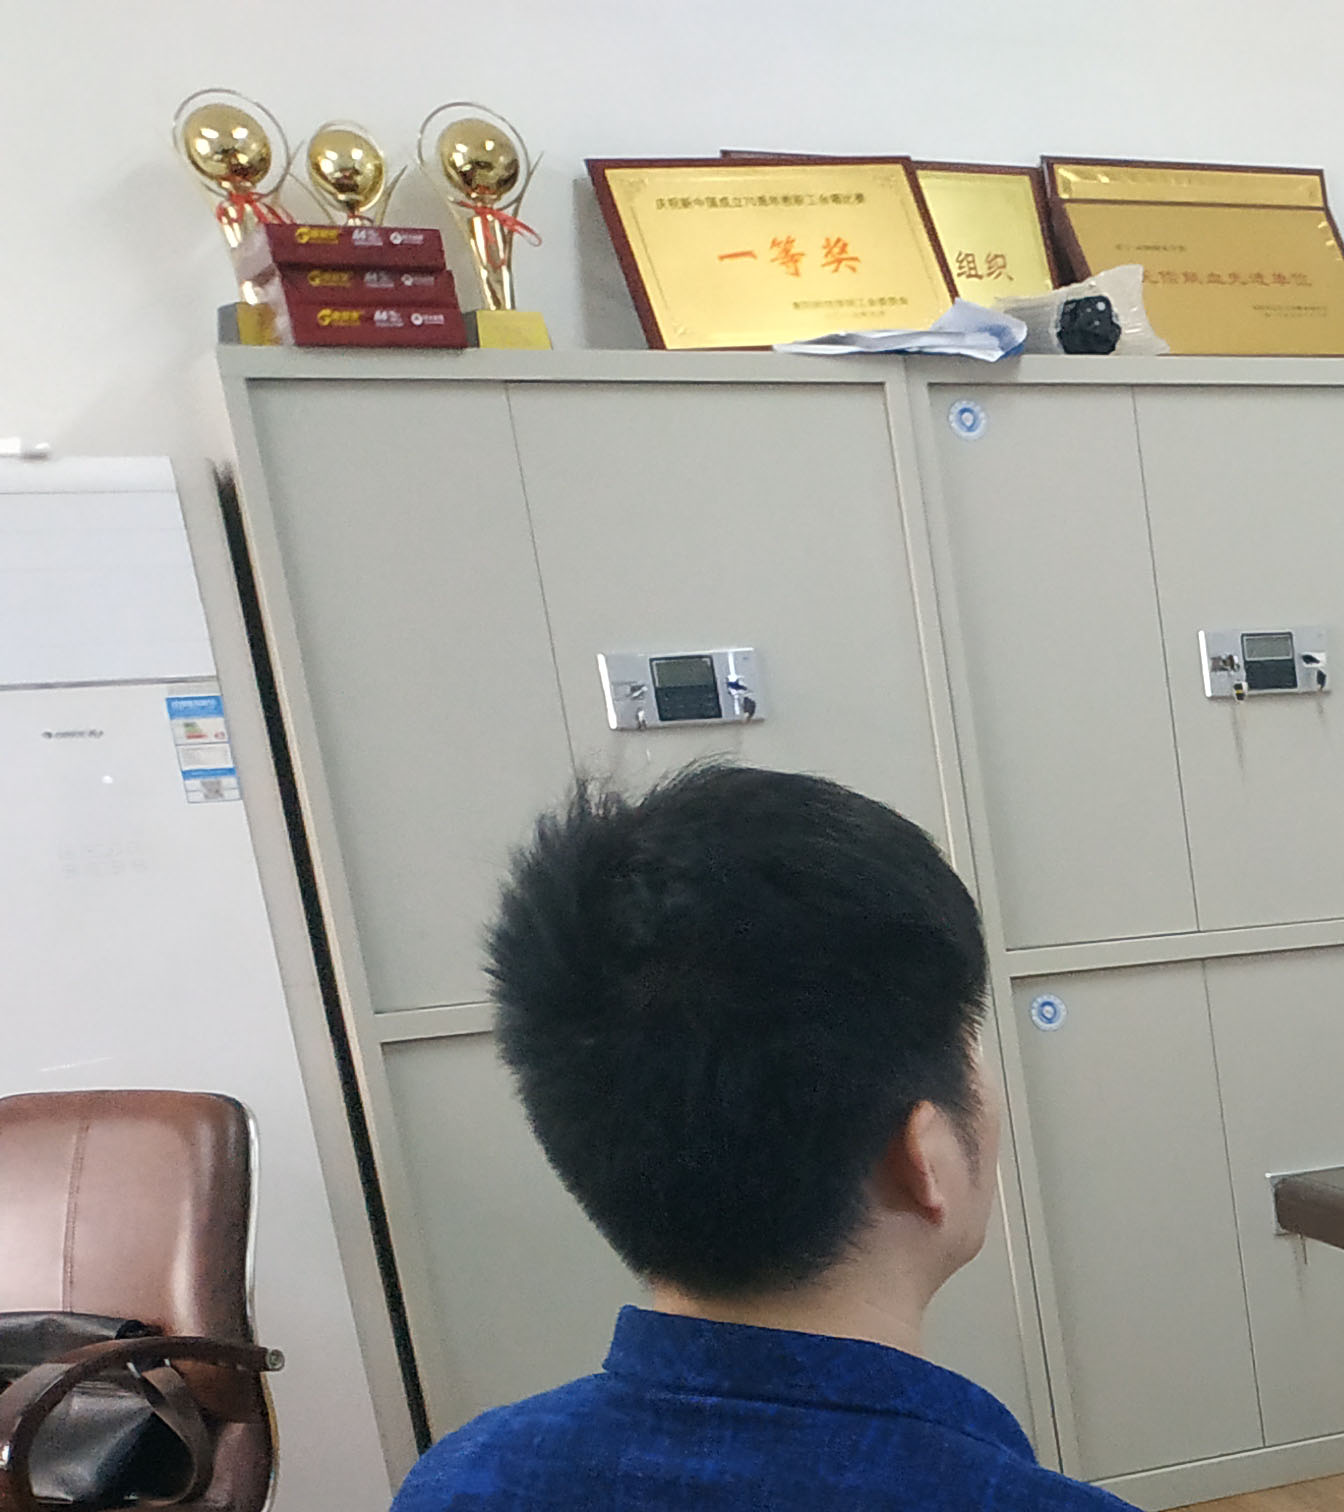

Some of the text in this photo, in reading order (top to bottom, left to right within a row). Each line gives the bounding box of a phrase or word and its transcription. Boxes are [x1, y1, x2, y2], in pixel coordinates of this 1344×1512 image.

[717, 235, 861, 277] 一等奖
[955, 250, 1015, 281] 组织
